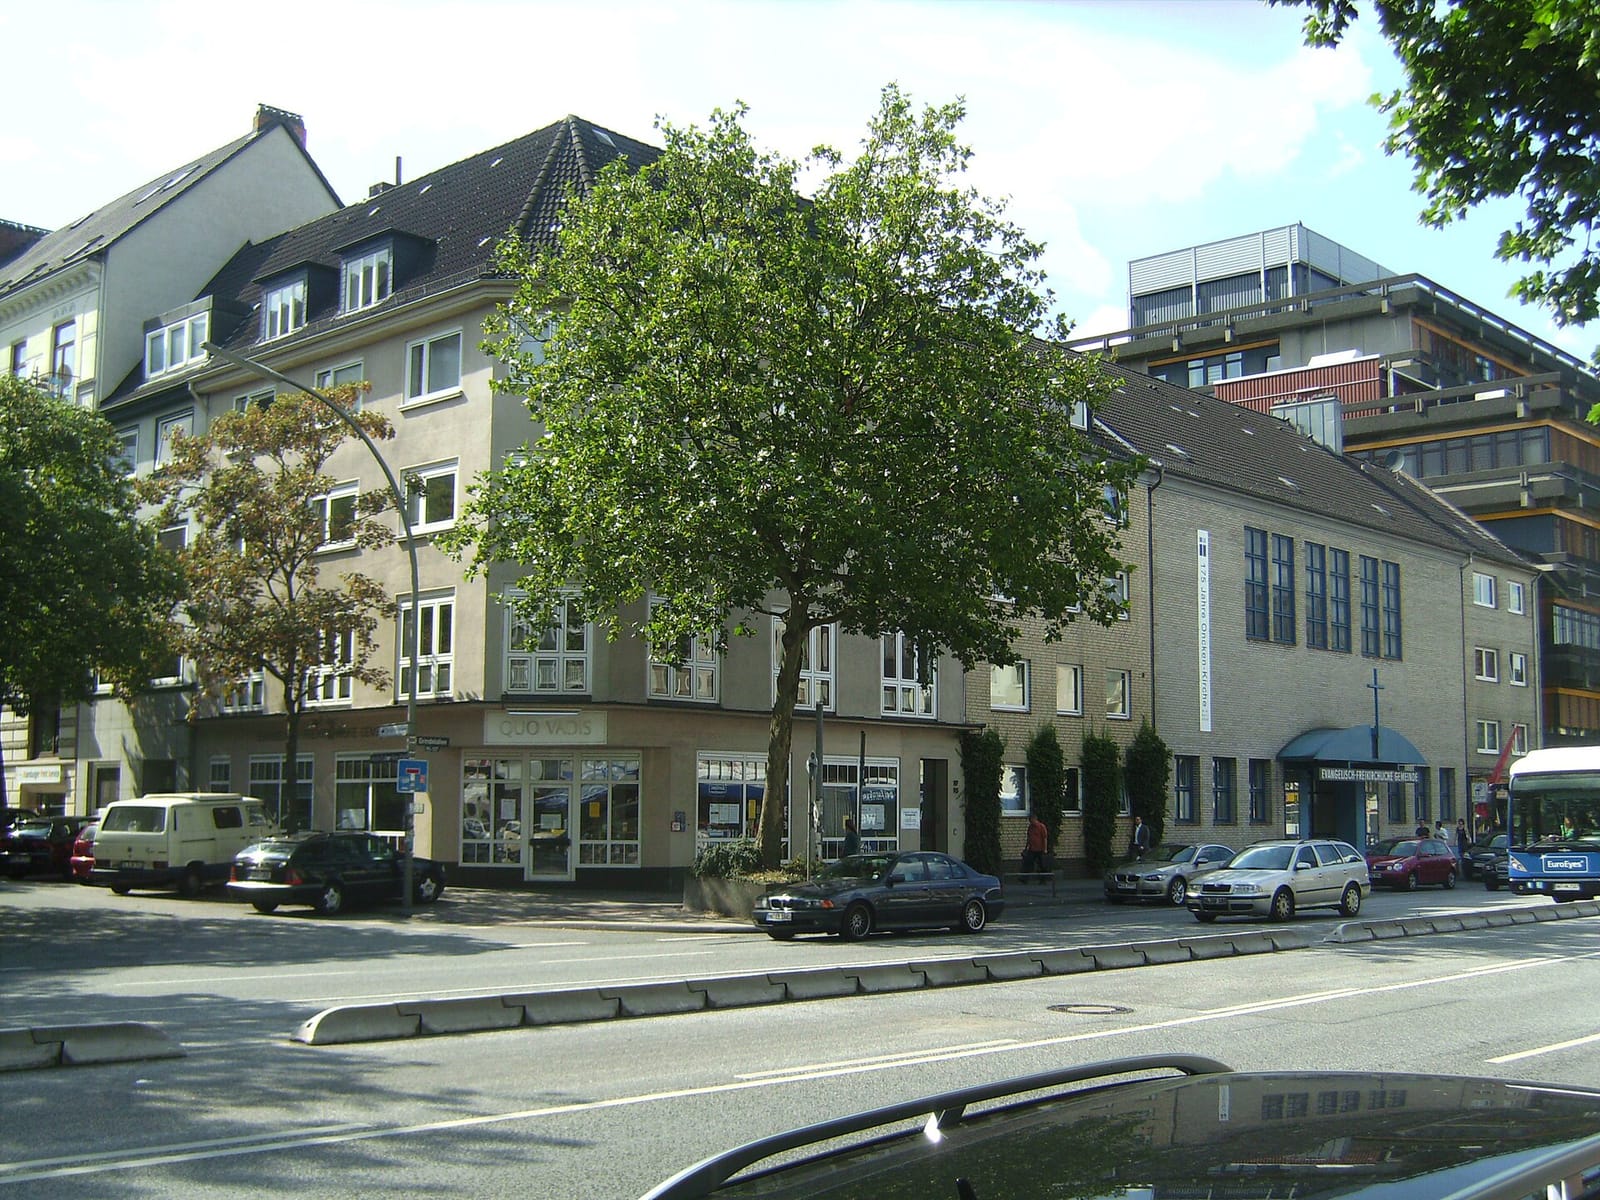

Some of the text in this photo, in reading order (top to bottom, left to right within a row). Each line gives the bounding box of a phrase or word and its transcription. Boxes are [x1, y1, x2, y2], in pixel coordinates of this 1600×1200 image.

[501, 720, 591, 738] QUO VADIS
[1321, 768, 1418, 782] EVANGELISCH-FREIKIRCHLICHE GEMEINDE
